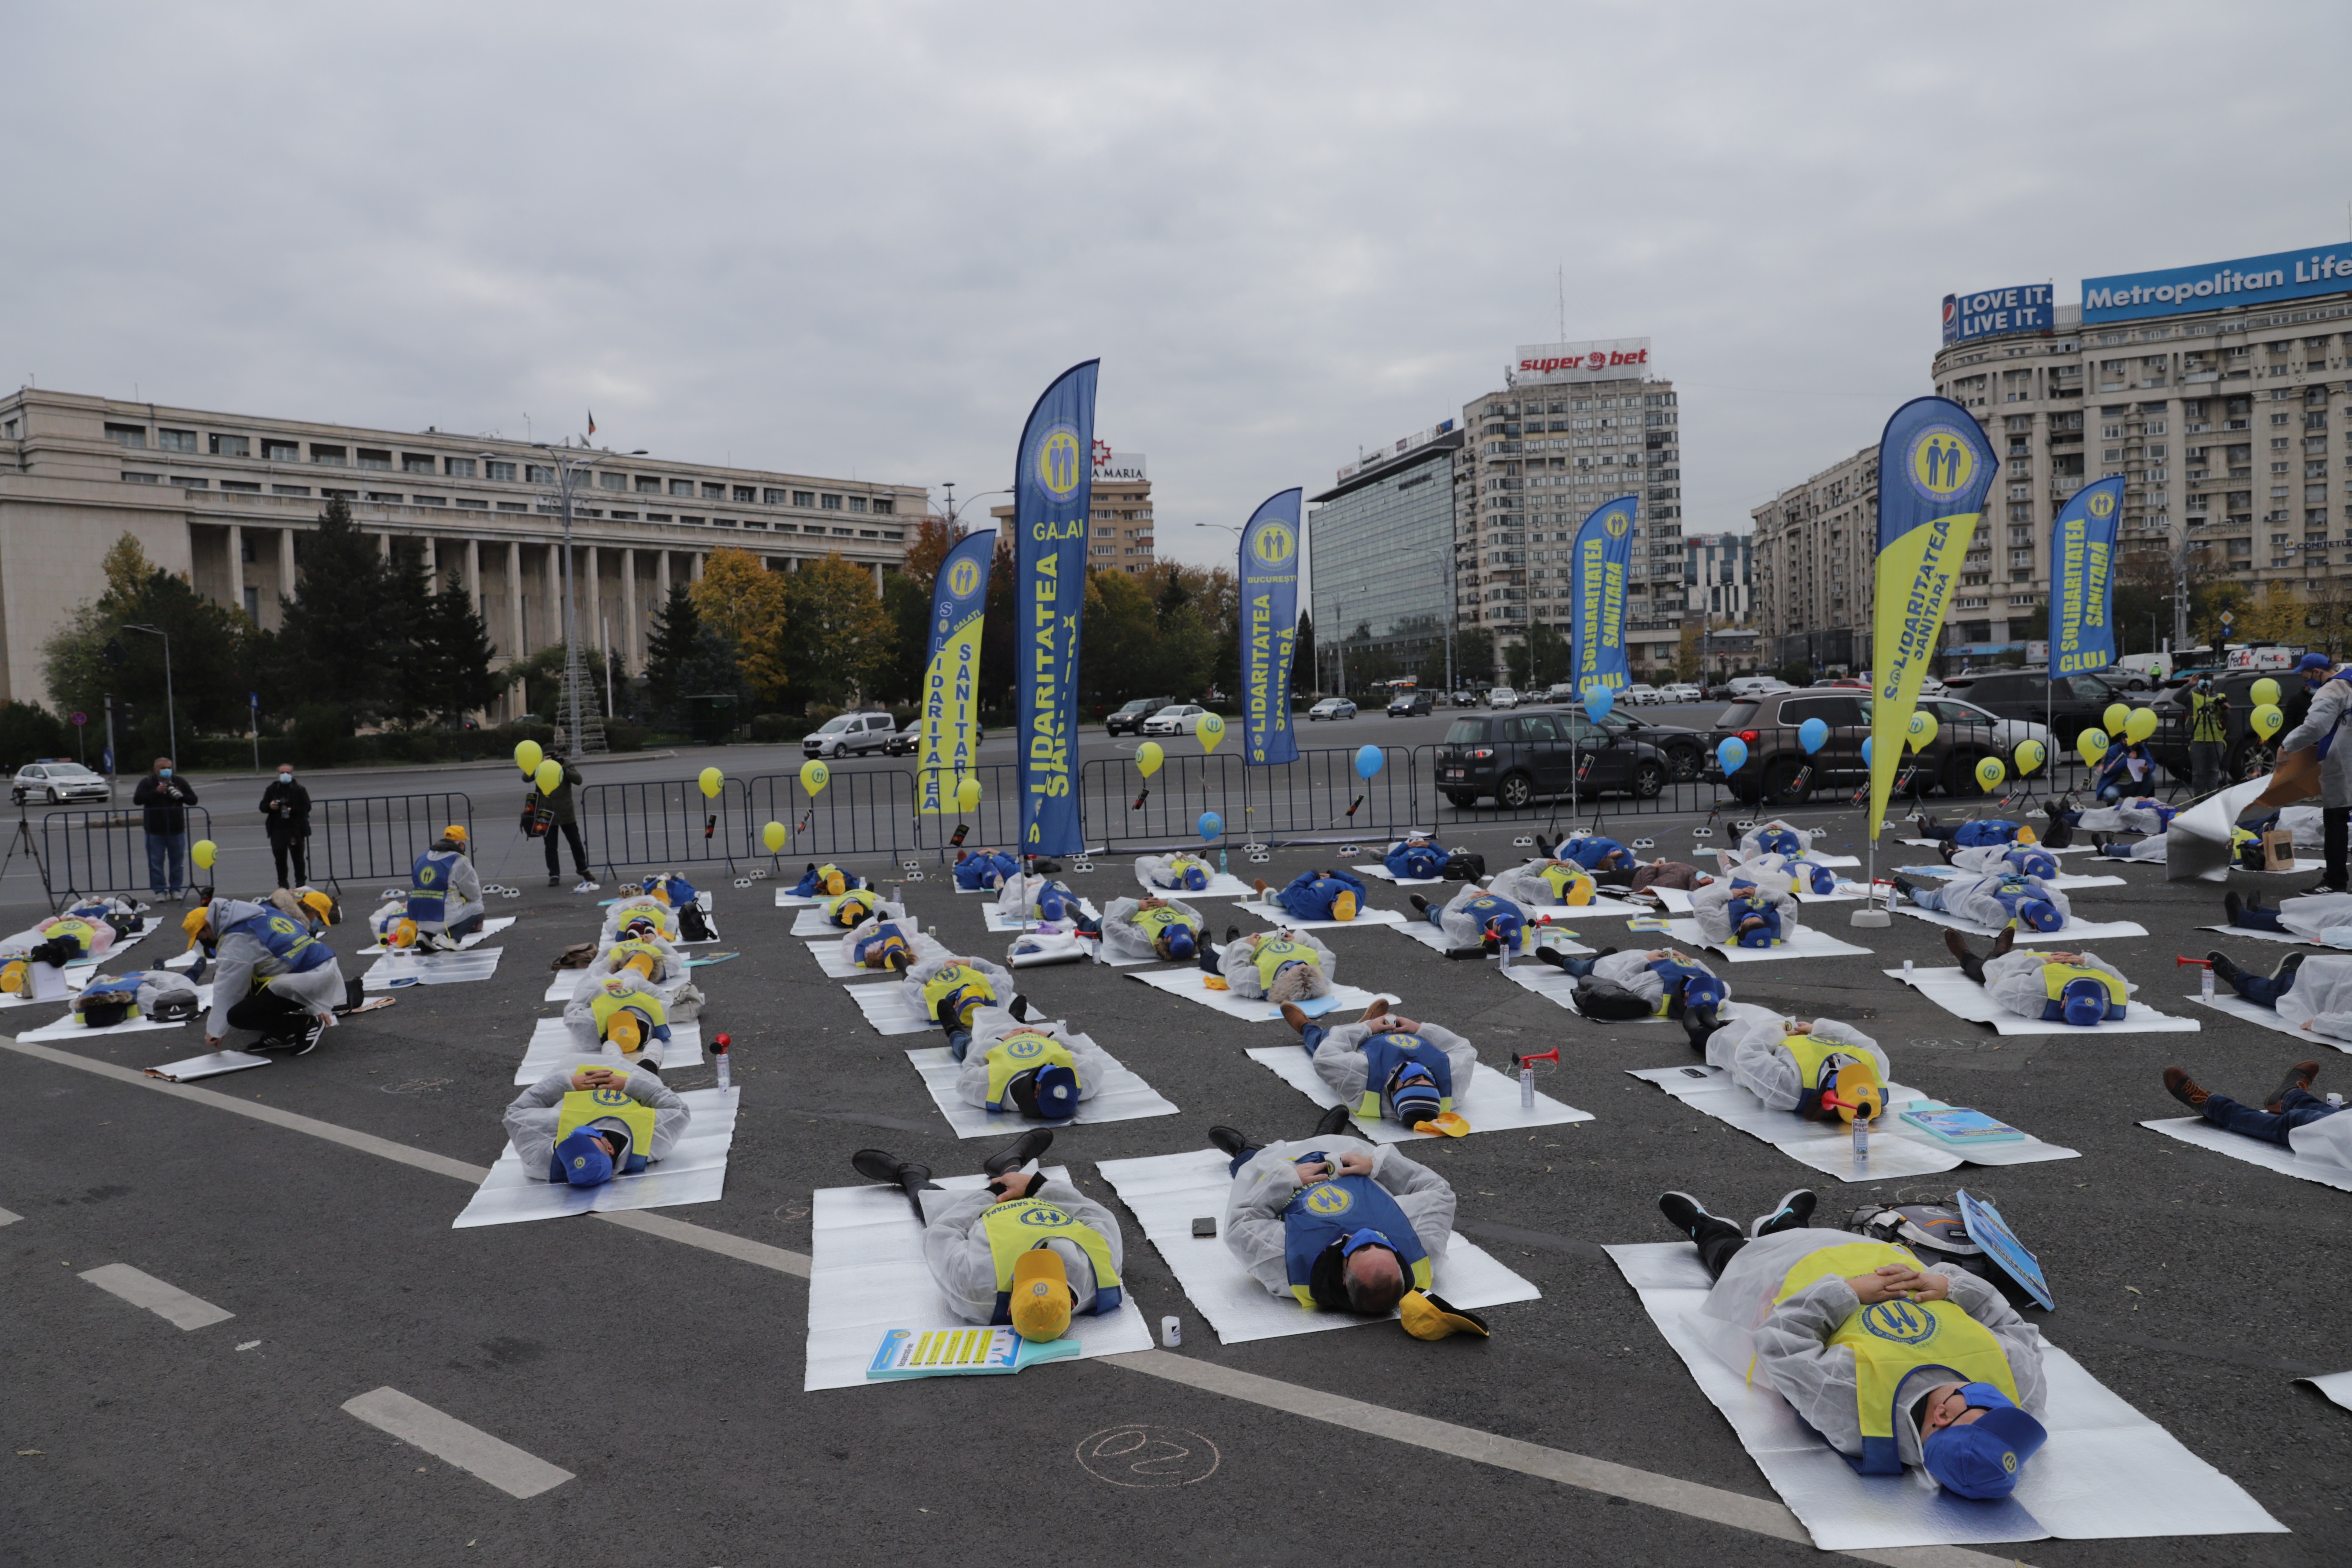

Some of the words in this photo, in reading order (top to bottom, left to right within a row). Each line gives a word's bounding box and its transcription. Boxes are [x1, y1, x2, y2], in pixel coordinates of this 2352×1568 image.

[1963, 290, 2017, 315] LOVE
[2025, 287, 2052, 305] IT.
[2086, 269, 2284, 310] Metropolitan
[1963, 311, 2008, 336] LIVE
[2016, 308, 2042, 327] IT.
[1520, 356, 1585, 373] super
[1609, 349, 1648, 365] bet
[1104, 468, 1143, 478] MARIA
[2060, 519, 2085, 652] SOLIDARITATEA
[2085, 541, 2108, 627] SANITARĂ
[1581, 538, 1603, 672] SOLIDARITATEA
[1602, 561, 1623, 648] SANITARĂ
[1914, 573, 1950, 661] SANITARĂ
[2059, 650, 2107, 672] CLUJ
[2229, 651, 2251, 668] FedEx
